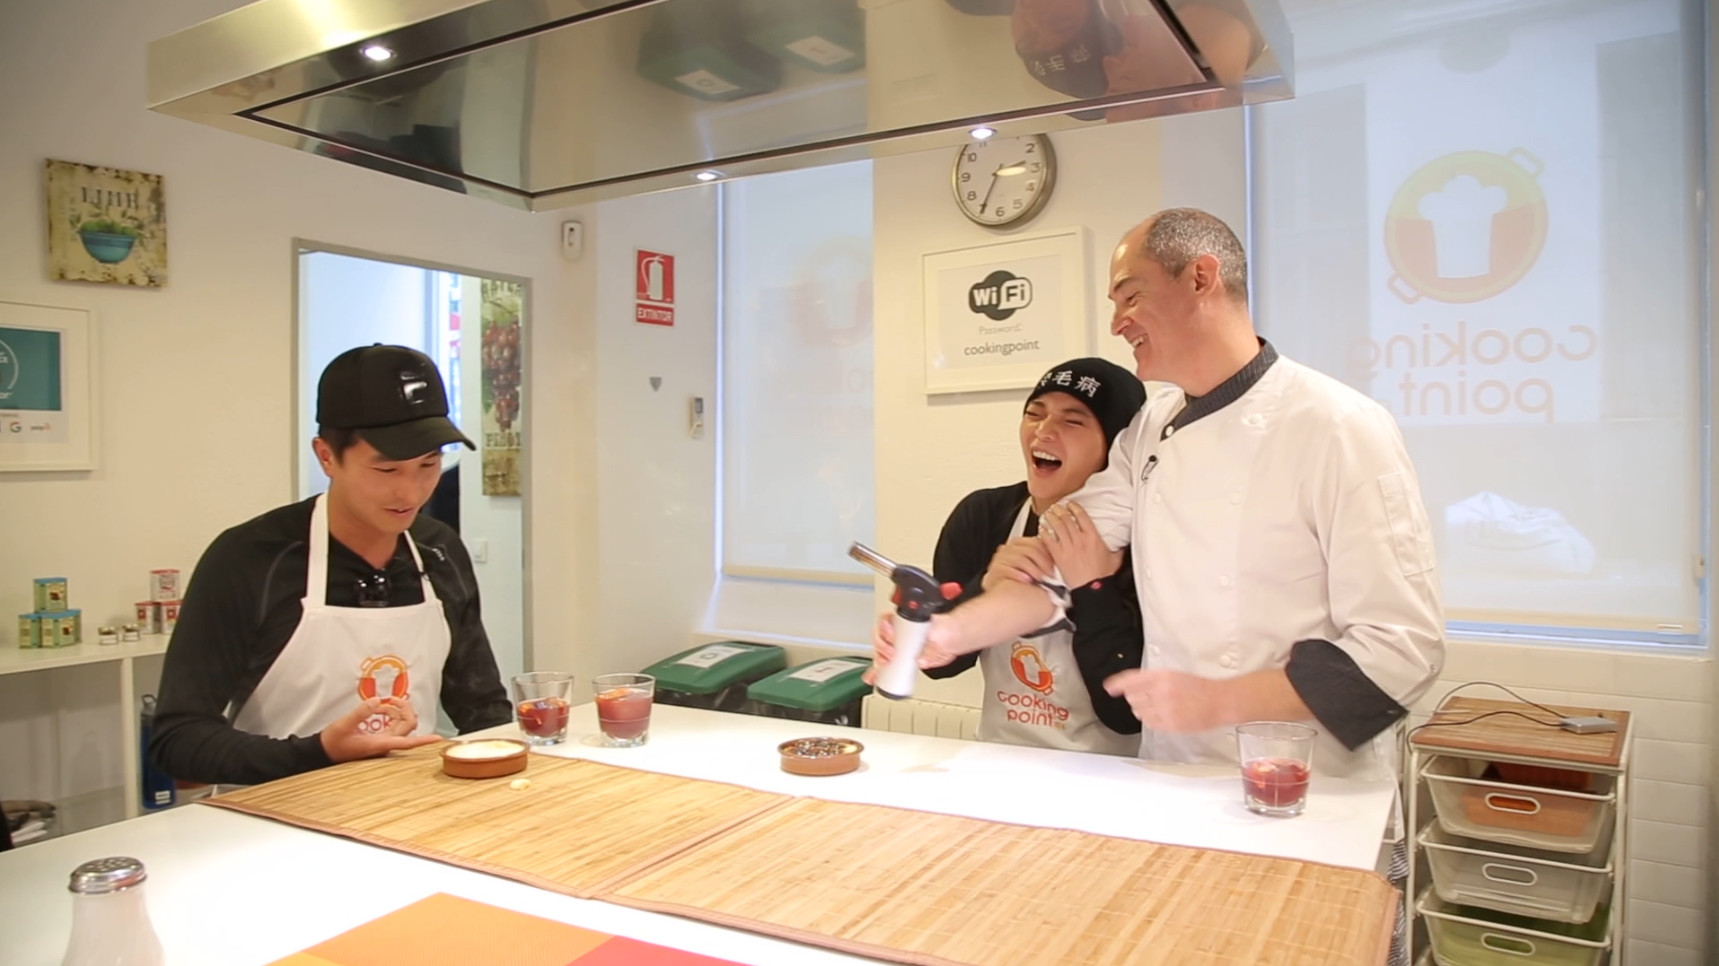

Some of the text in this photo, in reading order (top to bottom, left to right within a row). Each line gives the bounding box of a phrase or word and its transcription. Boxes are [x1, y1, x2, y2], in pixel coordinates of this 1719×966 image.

[1025, 143, 1035, 153] 2
[967, 152, 977, 162] 10
[1030, 162, 1041, 173] 3
[961, 172, 971, 183] 9
[967, 190, 977, 201] 8
[1013, 199, 1023, 209] 5
[996, 206, 1005, 217] 6
[637, 306, 672, 322] EXTINTOR
[964, 340, 1040, 356] cookingpoint
[997, 690, 1069, 721] cooking
[1007, 709, 1054, 727] point
